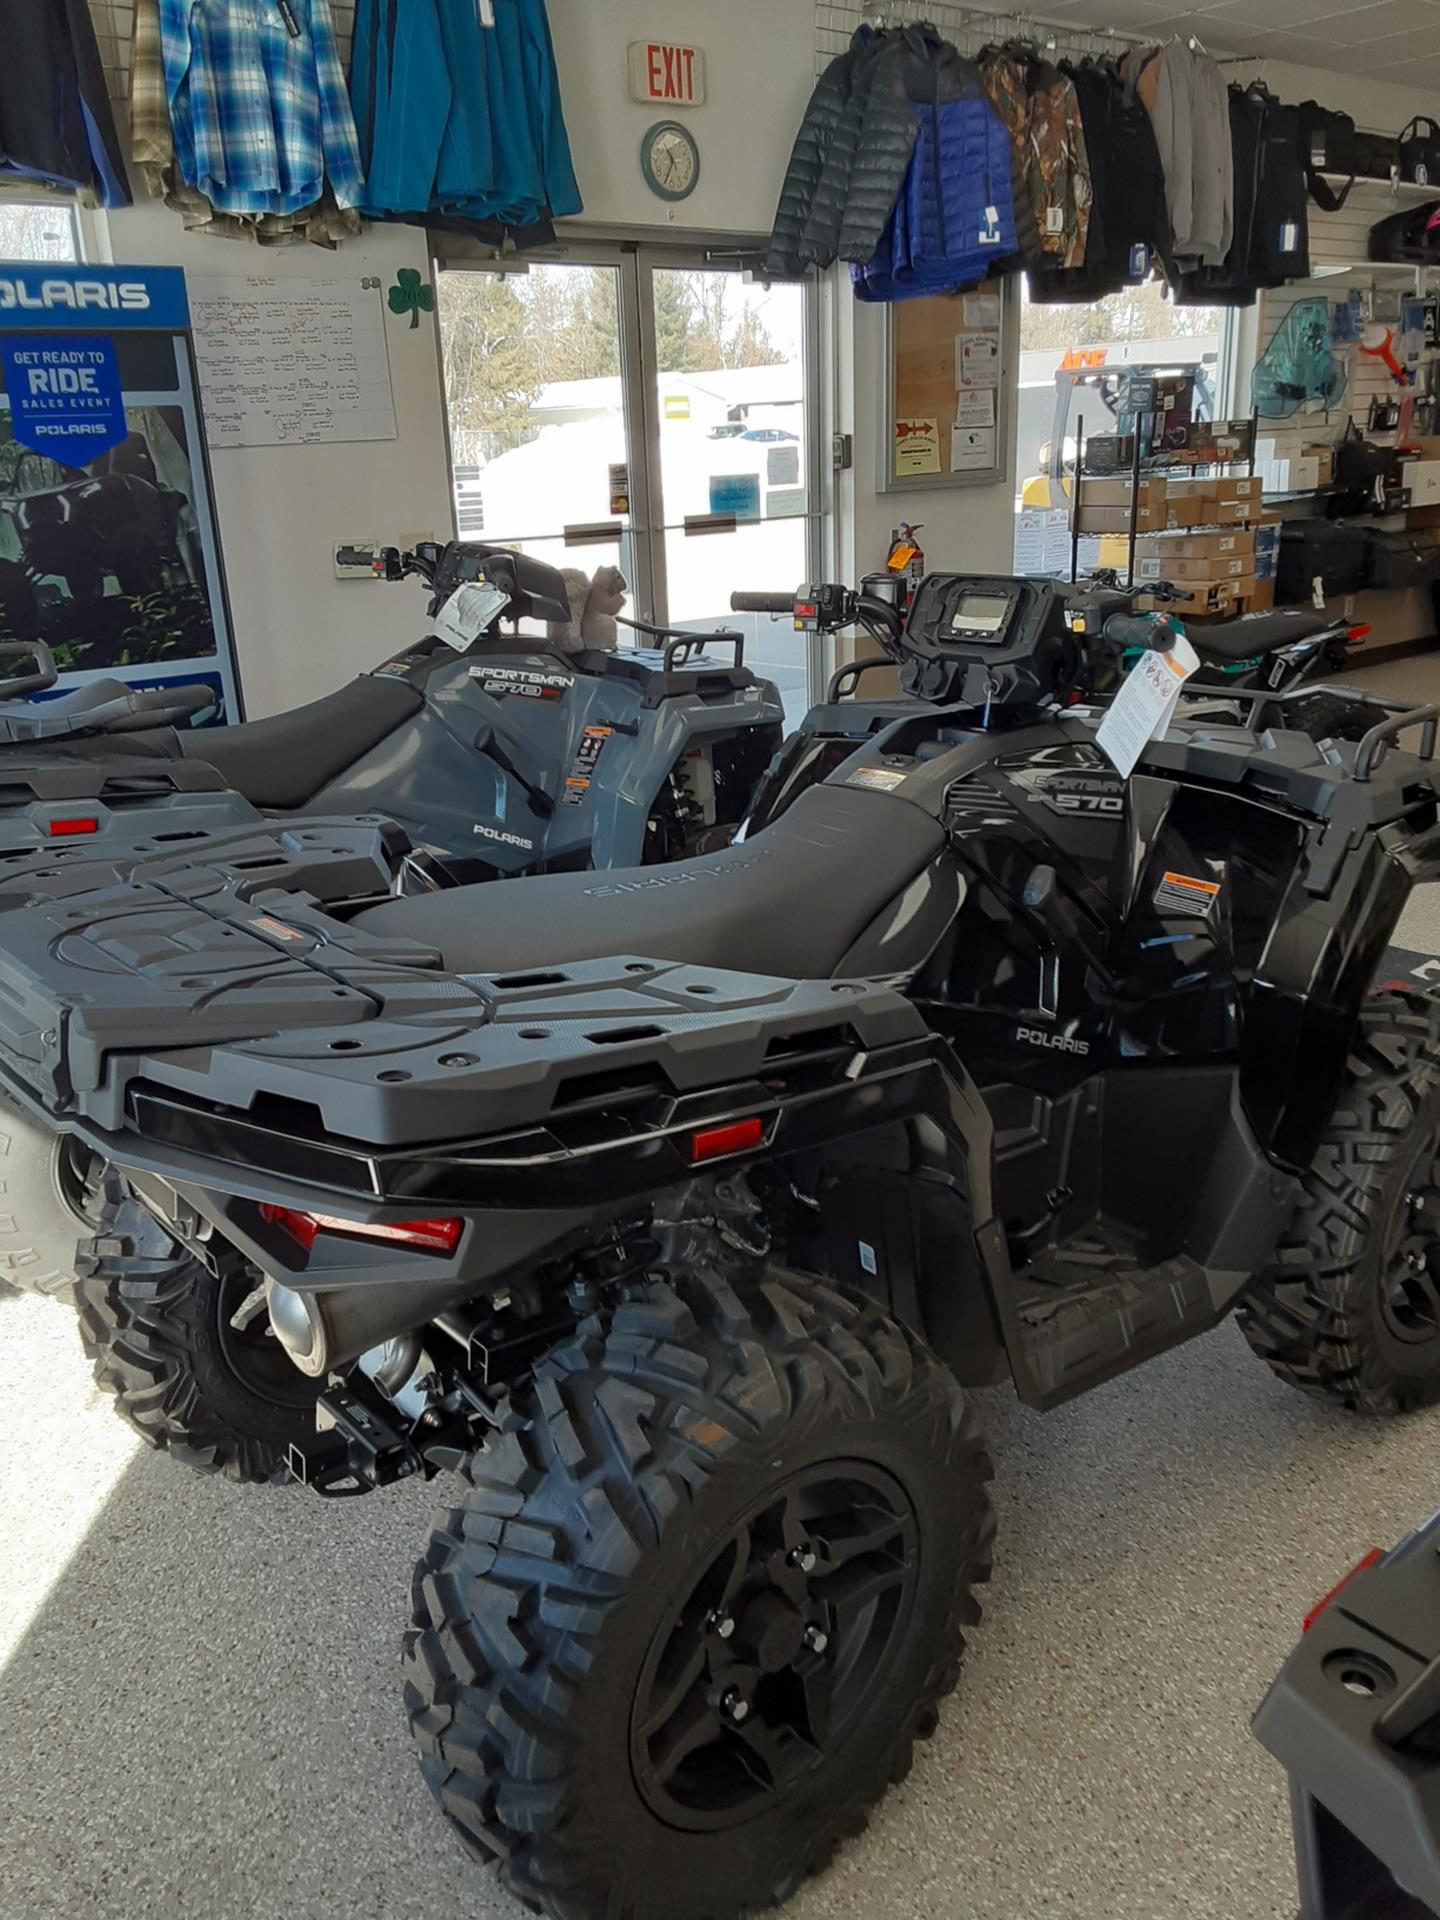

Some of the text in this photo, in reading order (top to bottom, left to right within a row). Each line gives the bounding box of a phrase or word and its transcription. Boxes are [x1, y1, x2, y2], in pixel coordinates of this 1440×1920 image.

[647, 44, 694, 100] EXIT
[13, 351, 105, 365] GET READY TO
[27, 367, 100, 395] RIDE
[21, 397, 112, 409] SALES EVENT
[34, 423, 108, 436] POLARIS
[467, 665, 576, 688] SPORTSMAN
[483, 679, 543, 697] 570
[1055, 794, 1124, 811] 570
[472, 823, 534, 850] POLARIS
[1015, 1026, 1090, 1055] POLARIS
